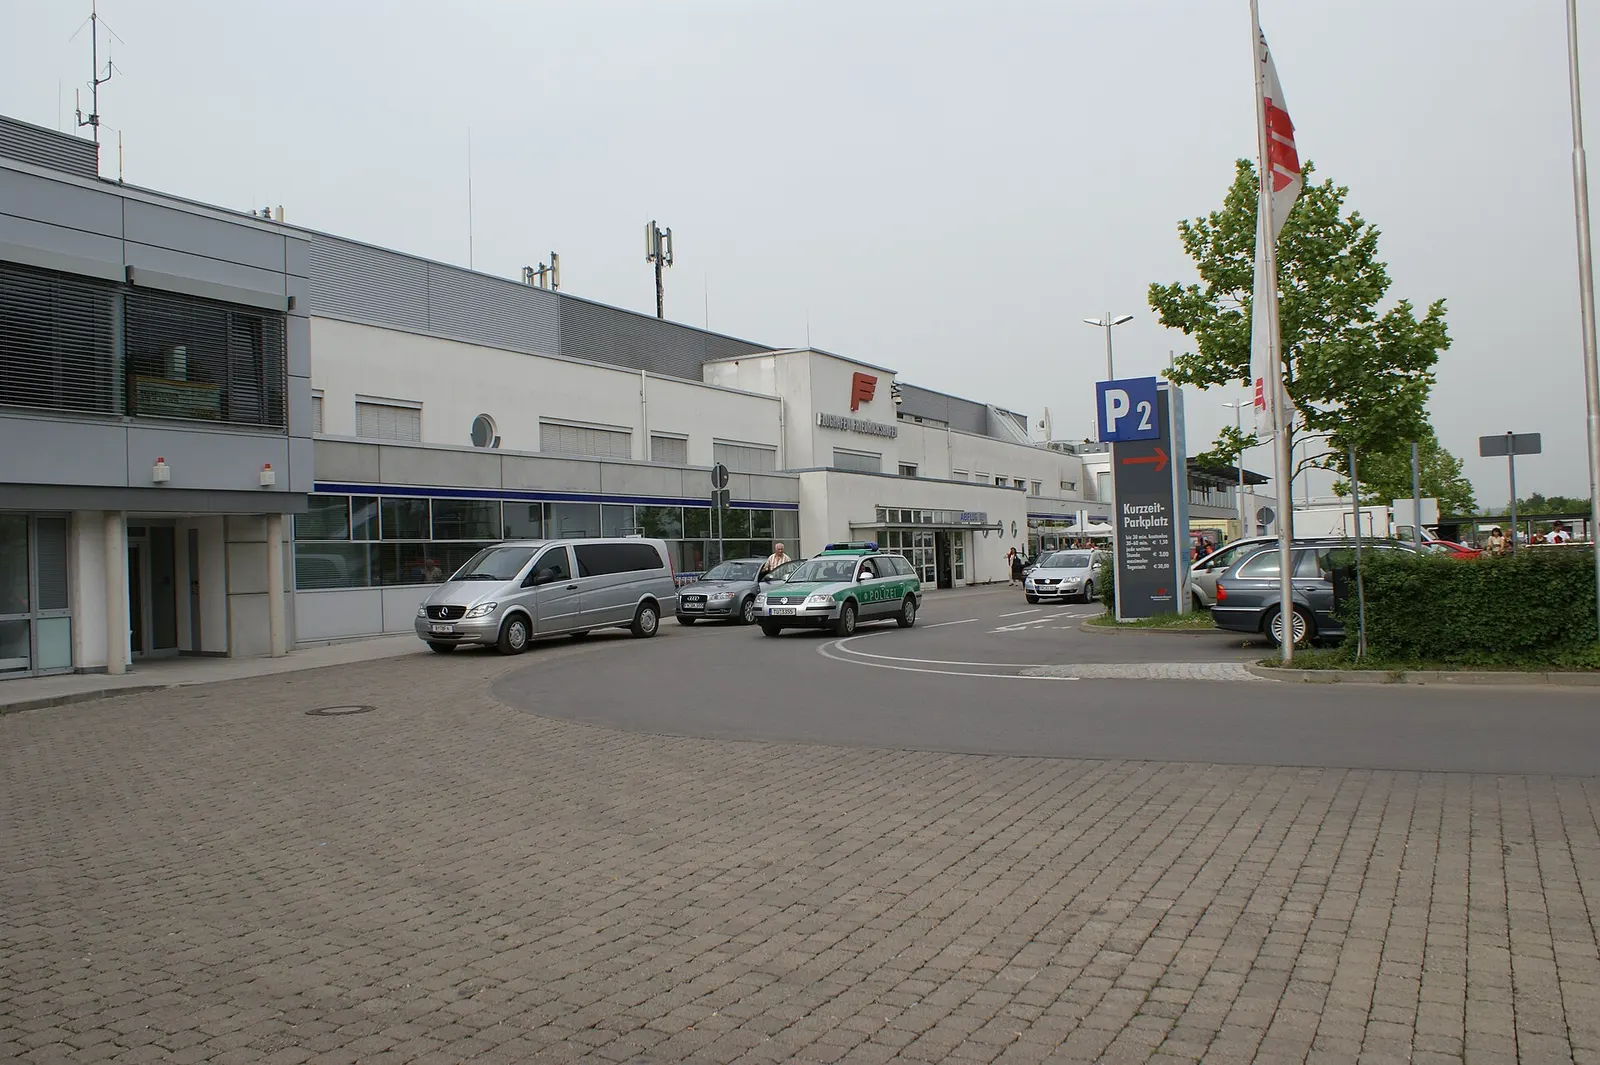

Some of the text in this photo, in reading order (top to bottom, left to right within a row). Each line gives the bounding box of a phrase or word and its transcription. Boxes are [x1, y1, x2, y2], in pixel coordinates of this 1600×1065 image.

[1105, 389, 1152, 433] P 2
[1123, 503, 1165, 514] Kurzzeit-
[1124, 515, 1168, 529] Parkplatz
[870, 588, 897, 600] POLIZEI
